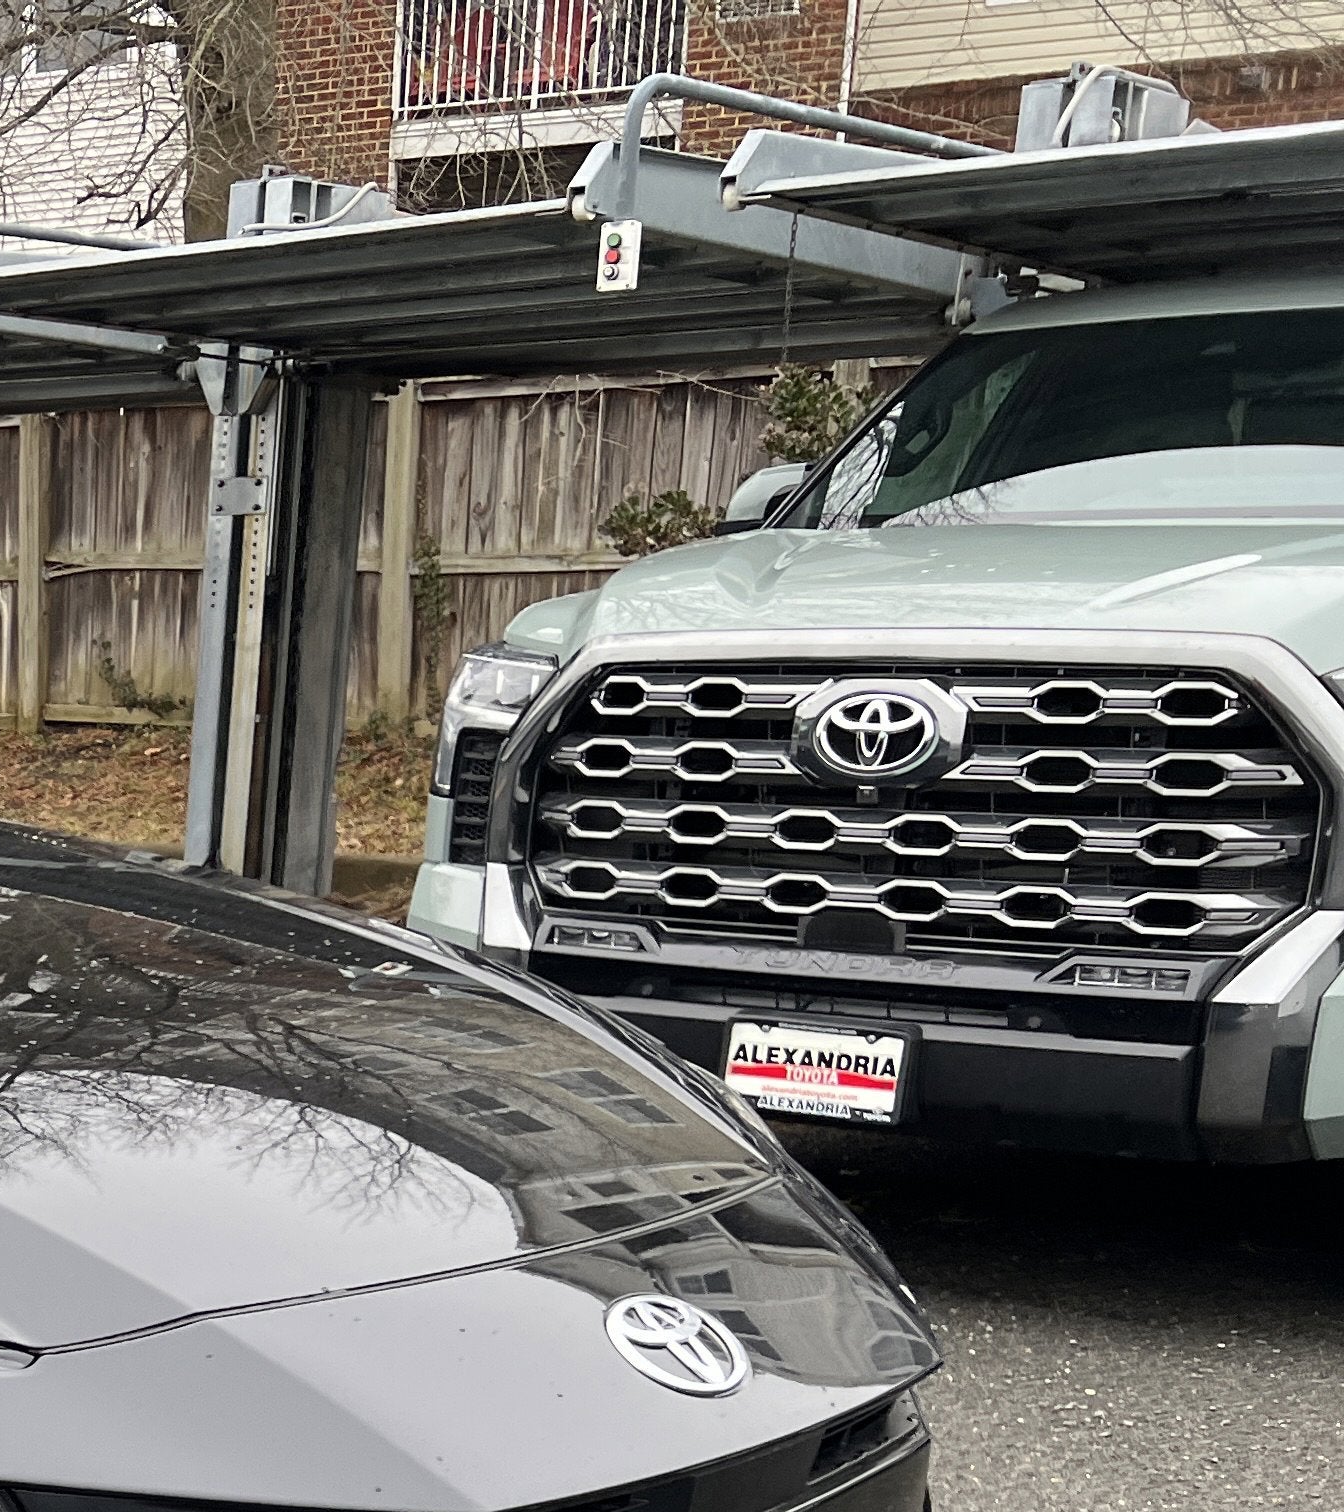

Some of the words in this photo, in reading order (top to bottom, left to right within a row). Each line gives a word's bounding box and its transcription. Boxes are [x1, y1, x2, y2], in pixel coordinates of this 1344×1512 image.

[729, 944, 956, 981] TUNDRA
[733, 1043, 896, 1077] ALEXANDRIA
[785, 1065, 839, 1086] TOYOTA
[758, 1095, 850, 1117] ALEXANDRIA
